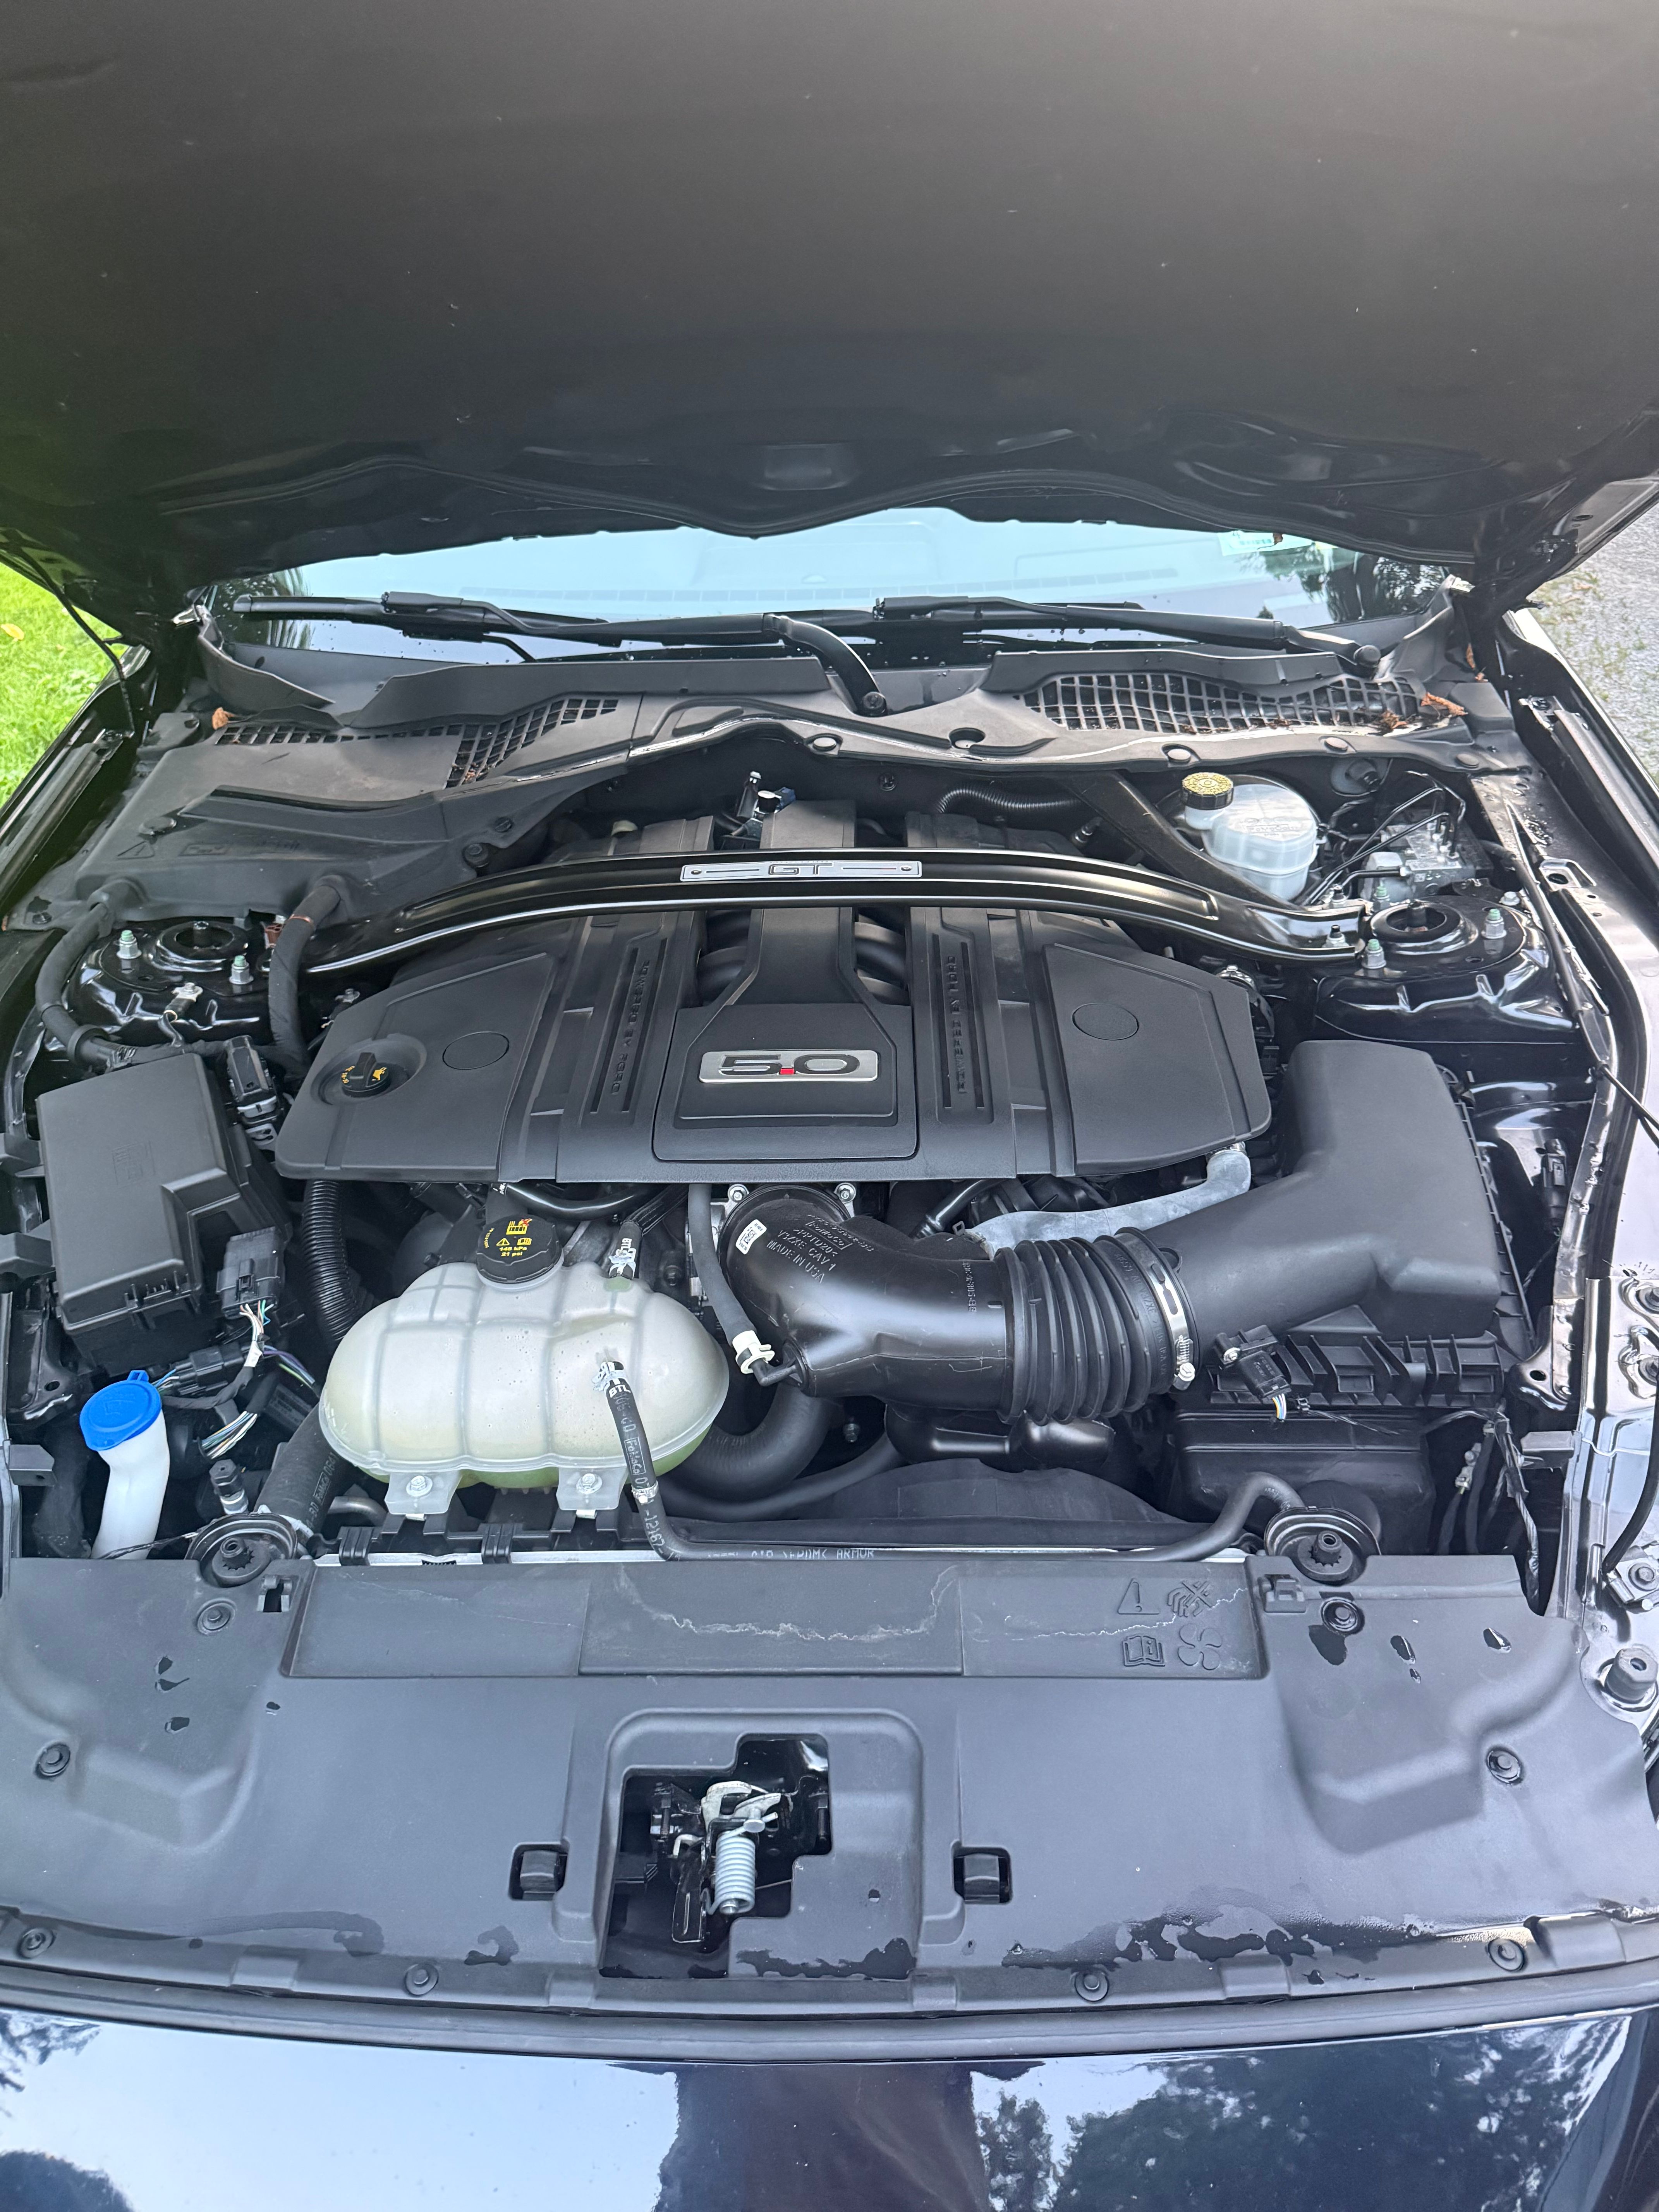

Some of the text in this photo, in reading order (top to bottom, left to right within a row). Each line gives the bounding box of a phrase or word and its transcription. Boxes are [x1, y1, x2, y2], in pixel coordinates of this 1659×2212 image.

[768, 863, 833, 876] GT
[718, 1054, 860, 1076] 5.0
[808, 1223, 845, 1246] FoMoCo
[766, 1240, 795, 1259] MADE
[793, 1254, 805, 1266] IN
[805, 1262, 824, 1284] USA
[808, 1248, 830, 1264] CAV
[609, 1384, 631, 1398] BTL
[836, 1549, 874, 1559] ARMOR
